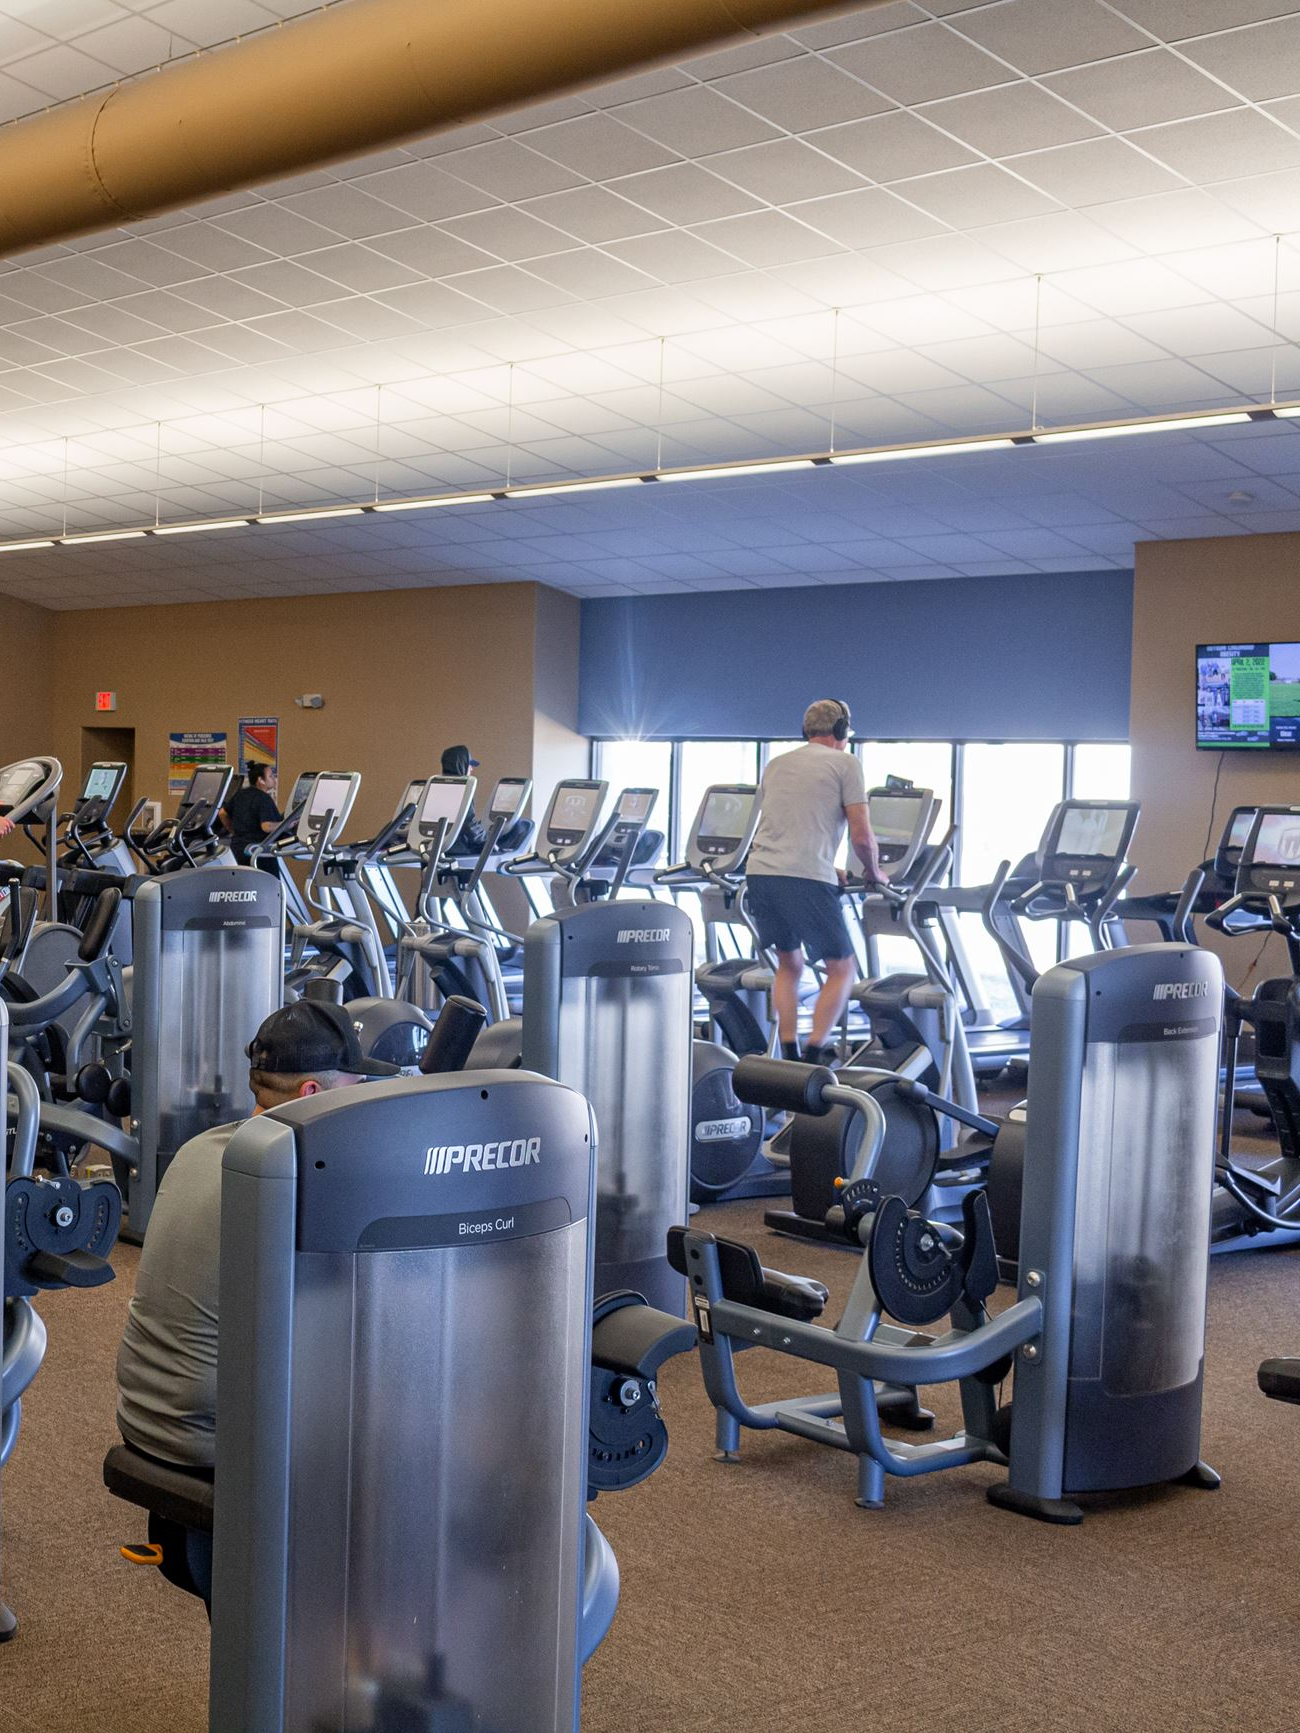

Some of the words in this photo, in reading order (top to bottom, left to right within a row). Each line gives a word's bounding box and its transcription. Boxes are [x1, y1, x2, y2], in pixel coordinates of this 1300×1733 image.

[217, 891, 257, 902] PRECOR
[626, 928, 670, 943] PRECOR
[1163, 981, 1208, 1000] PRECOR
[444, 1137, 541, 1174] PRECOR
[458, 1222, 493, 1235] Biceps
[495, 1216, 514, 1230] Curl
